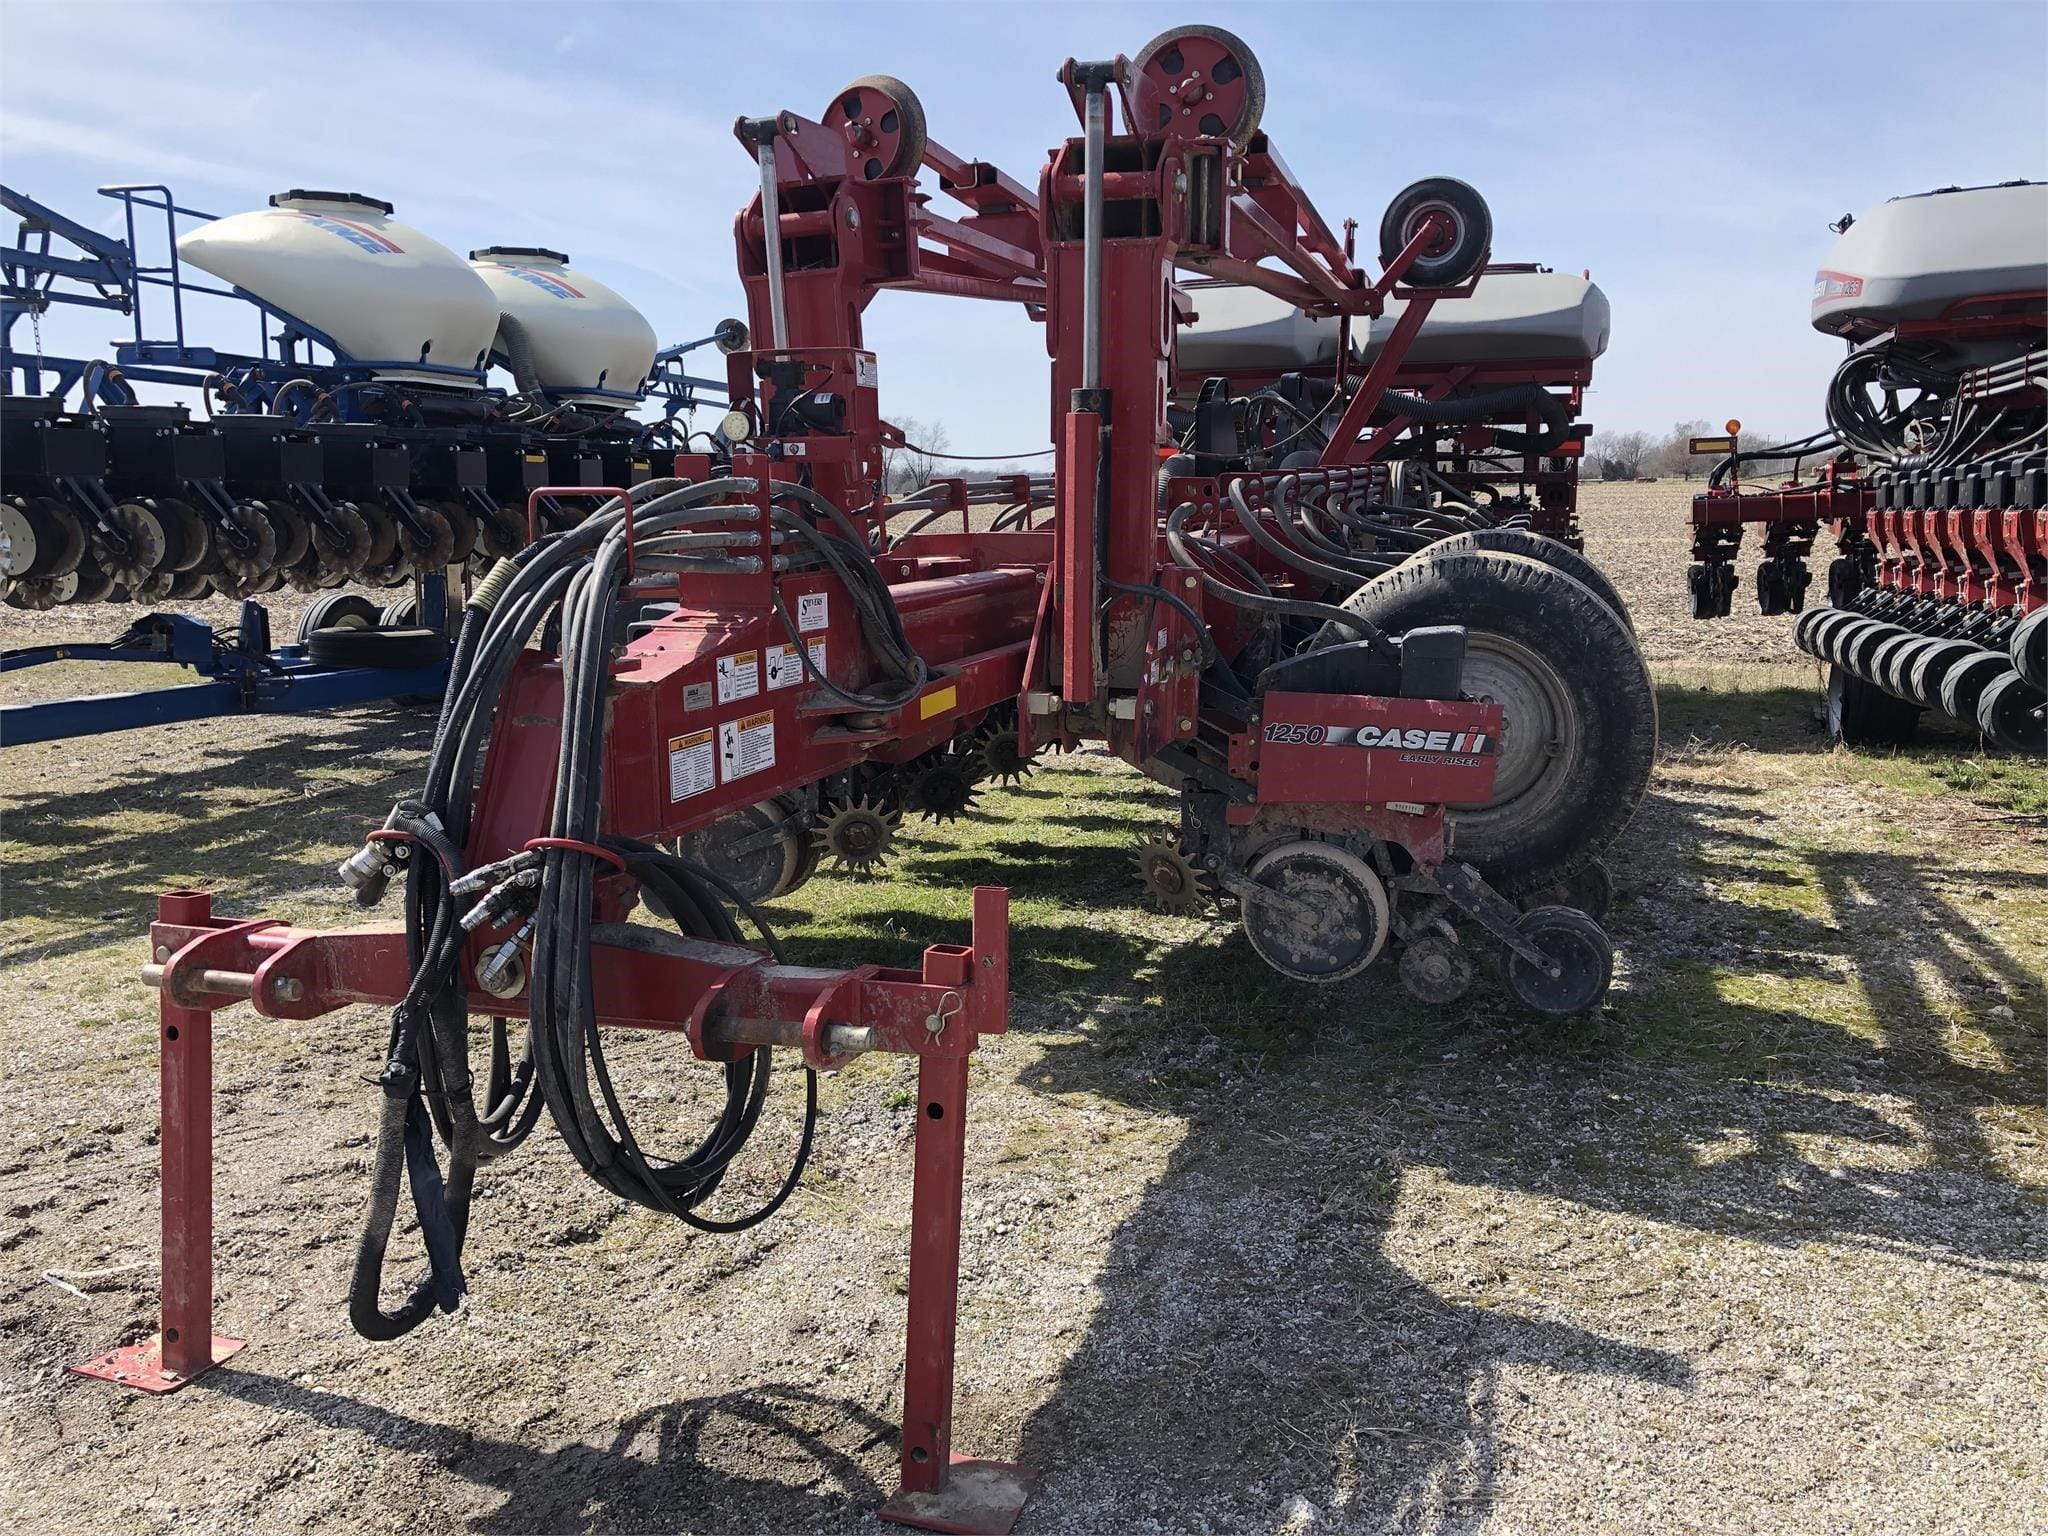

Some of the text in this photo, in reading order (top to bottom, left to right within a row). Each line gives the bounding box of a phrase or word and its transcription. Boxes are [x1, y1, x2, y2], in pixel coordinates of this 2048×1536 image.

[306, 218, 391, 254] KINZE
[505, 268, 576, 299] KINZE
[746, 713, 771, 728] WARNING
[1264, 723, 1326, 746] 1250
[1356, 725, 1452, 750] CASE
[1399, 753, 1481, 767] EARLY RISER
